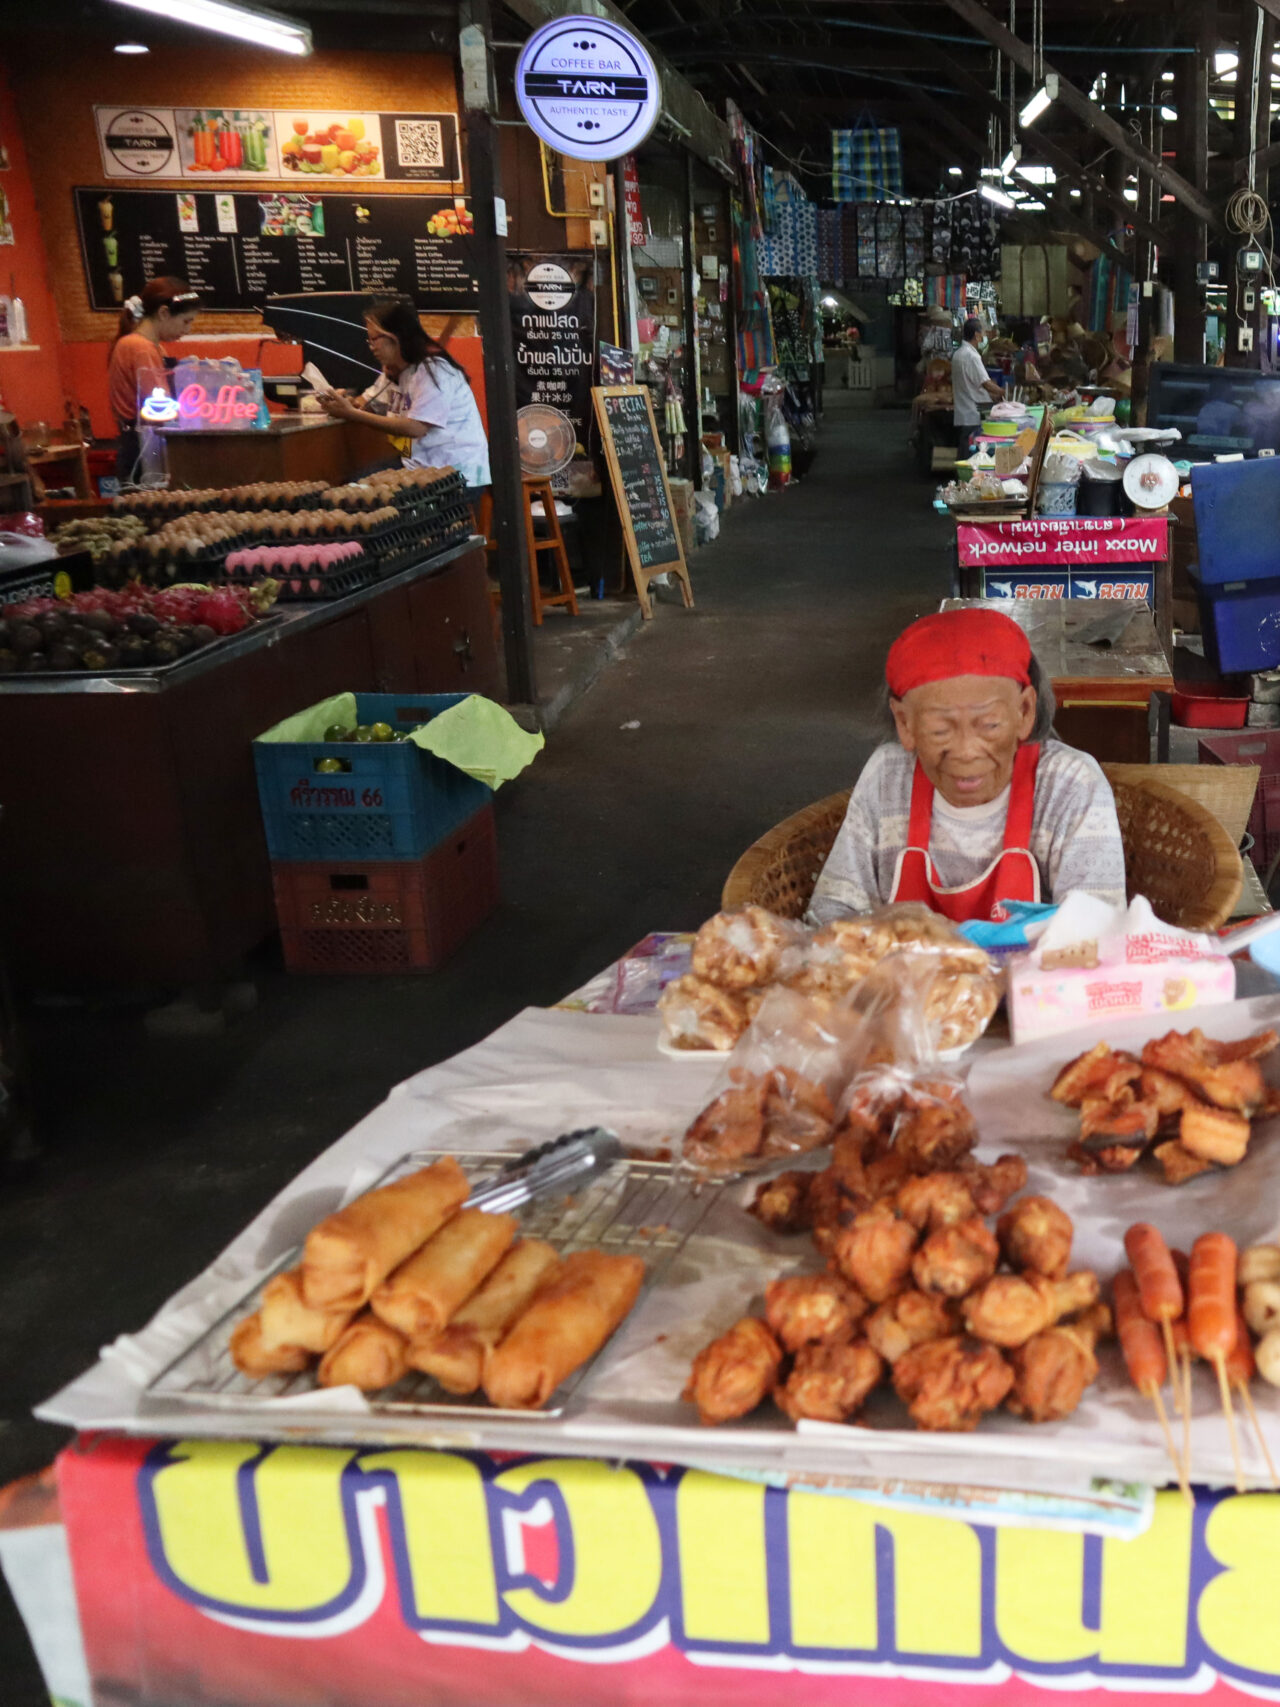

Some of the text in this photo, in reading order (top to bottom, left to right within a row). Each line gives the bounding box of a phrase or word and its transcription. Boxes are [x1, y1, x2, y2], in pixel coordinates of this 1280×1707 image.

[551, 57, 622, 70] COFFEE BAR
[557, 79, 616, 96] TARN
[550, 106, 629, 117] AUTHENTIC TASTE
[124, 138, 157, 148] TARN
[537, 283, 562, 291] TARN
[522, 311, 579, 328] กาแฟสด
[527, 328, 579, 340] เริ่มต้น 25 บาท
[517, 343, 593, 366] น้ำผลไม้ปั่น
[527, 365, 580, 376] เริ่มต้น 35 บาท
[178, 384, 259, 424] Coffee
[605, 397, 646, 415] SPECIAL
[969, 538, 1158, 559] Maxx inter network
[1014, 583, 1149, 599] ฉลาม ฉลาม
[362, 788, 382, 807] 66
